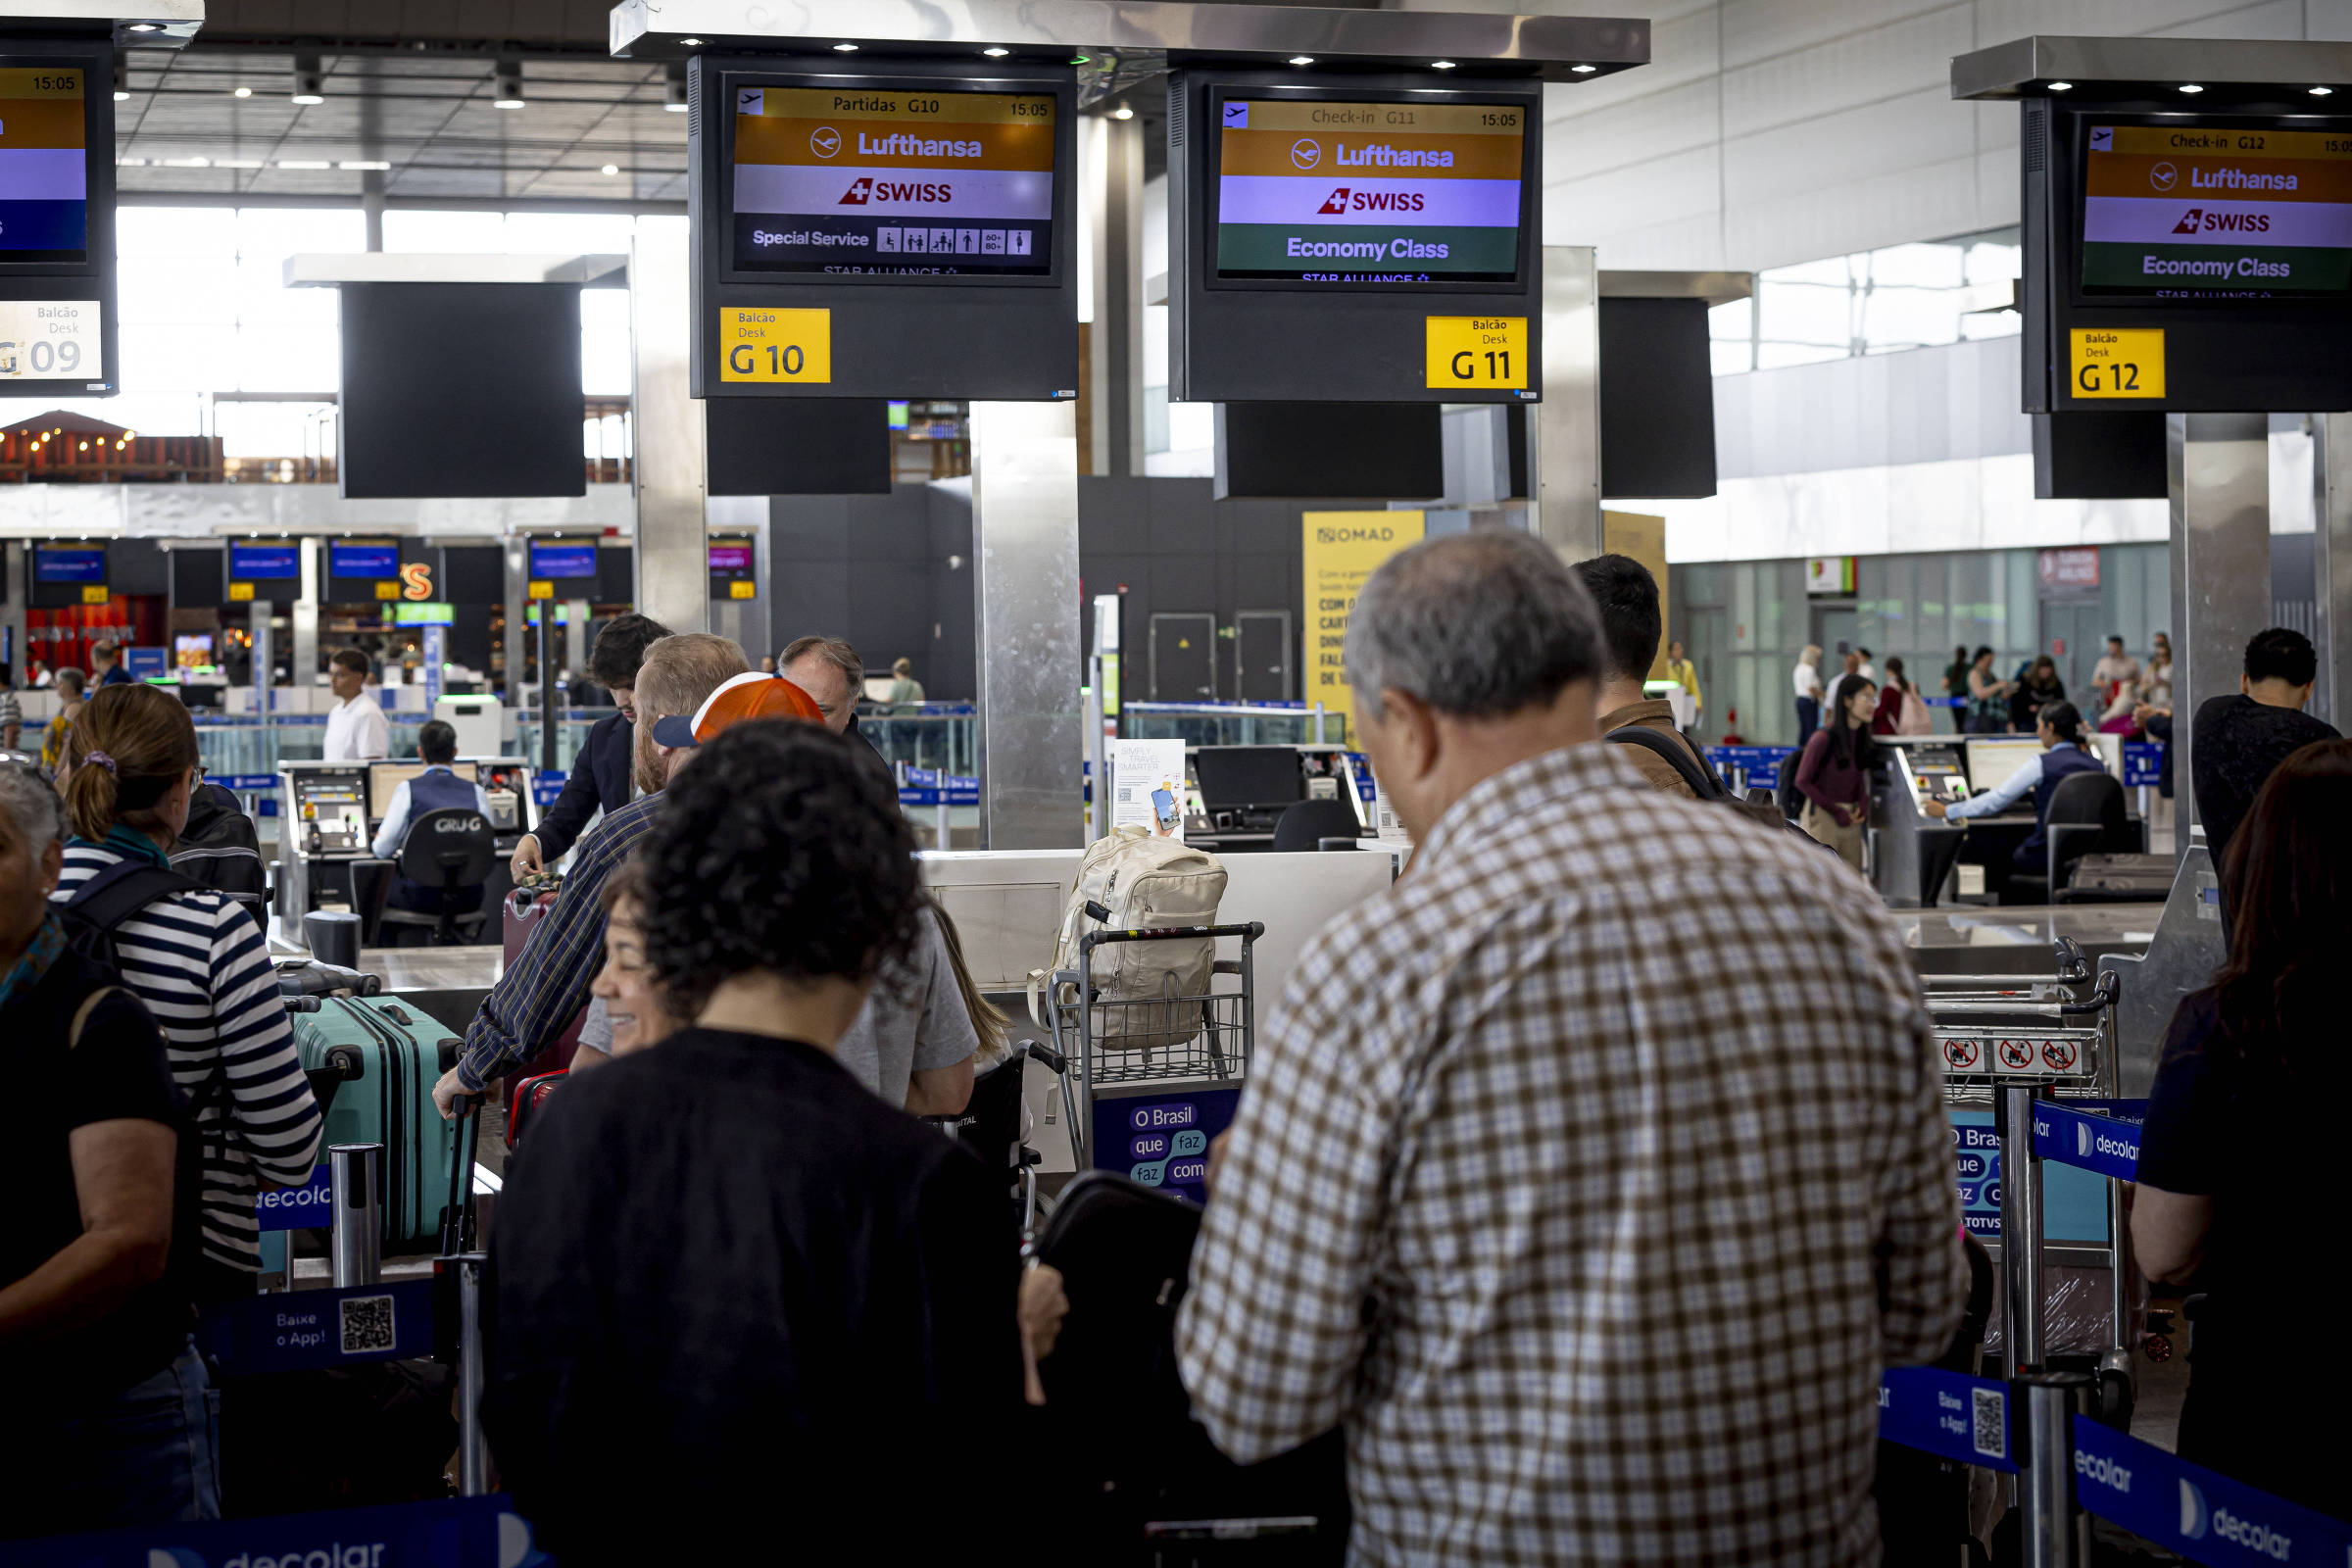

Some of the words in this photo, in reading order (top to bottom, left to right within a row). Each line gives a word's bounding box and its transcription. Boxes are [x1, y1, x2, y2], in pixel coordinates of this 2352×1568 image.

[33, 76, 75, 90] 15:05
[833, 97, 896, 113] Partidas
[907, 99, 940, 113] G10
[1010, 103, 1048, 117] 15:05
[1312, 109, 1375, 124] Check-in
[1387, 111, 1415, 125] G11
[1481, 114, 1516, 126] 15:05
[858, 132, 982, 158] Lufthansa
[2170, 134, 2228, 149] Check-in
[2237, 136, 2265, 150] G12
[1336, 144, 1454, 168] Lufthansa
[2191, 167, 2298, 190] Lufthansa
[875, 182, 952, 204] SWISS
[1352, 192, 1425, 212] SWISS
[2204, 213, 2270, 232] SWISS
[753, 229, 809, 247] Special
[810, 231, 869, 247] Service
[1287, 237, 1388, 263] Economy
[1391, 238, 1449, 260] Class
[2142, 255, 2234, 280] Economy
[2237, 257, 2290, 277] Class
[37, 306, 78, 318] Balcão
[738, 311, 776, 323] Balcão
[49, 322, 79, 334] Desk
[738, 326, 766, 338] Desk
[1472, 318, 1507, 330] Balcão
[1482, 333, 1507, 344] Desk
[2085, 332, 2118, 344] Balcão
[30, 341, 81, 373] 09
[729, 344, 755, 374] G
[766, 344, 805, 375] 10
[2085, 347, 2109, 358] Desk
[1451, 351, 1474, 380] G
[1485, 351, 1510, 380] 11
[2079, 364, 2100, 392] G
[2110, 363, 2140, 391] 12
[1319, 598, 1346, 612] COM
[1135, 1110, 1149, 1127] O
[1153, 1106, 1192, 1126] Brasil
[1136, 1140, 1163, 1155] que
[1179, 1135, 1200, 1150] faz
[1137, 1167, 1158, 1182] faz
[1173, 1163, 1204, 1178] com
[1957, 1159, 1979, 1172] ue
[276, 1313, 317, 1327] Baixe
[276, 1336, 286, 1346] o
[290, 1329, 325, 1348] App!
[2074, 1449, 2132, 1493] ecolar
[2213, 1506, 2291, 1562] decolar
